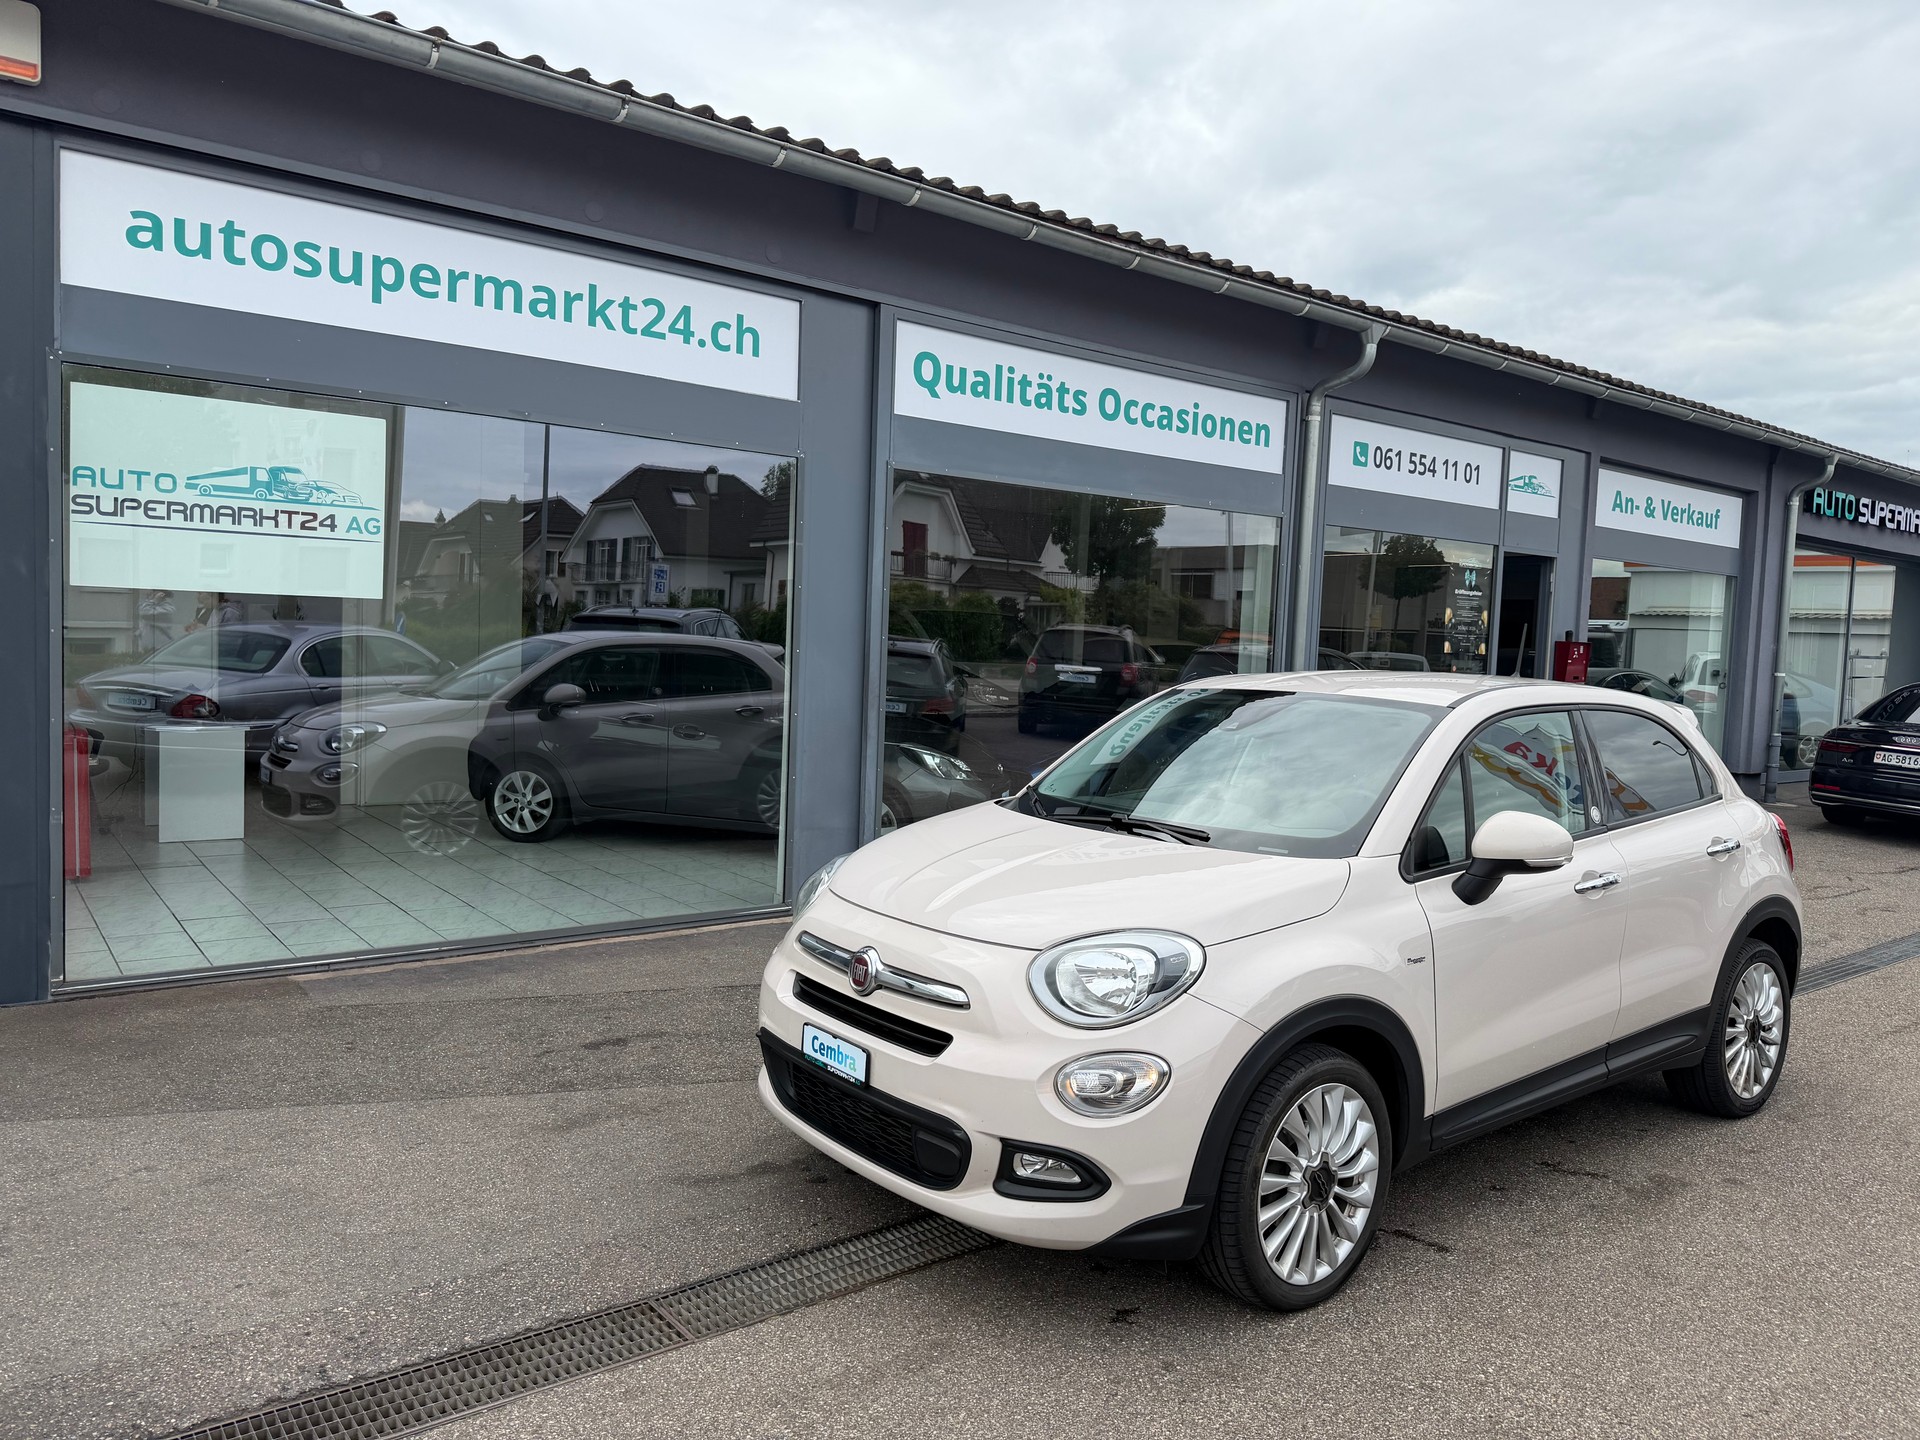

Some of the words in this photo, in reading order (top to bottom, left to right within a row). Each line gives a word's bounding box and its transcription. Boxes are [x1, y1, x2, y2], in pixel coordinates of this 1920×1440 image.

[126, 210, 761, 358] autosupermarkt24.ch
[913, 351, 1088, 416] Qualitäts
[1098, 387, 1271, 448] Occasionen
[72, 465, 177, 494] AUTO
[1373, 445, 1402, 472] 061
[1408, 452, 1437, 478] 554
[1442, 458, 1458, 481] 11
[1464, 462, 1480, 485] 01
[71, 493, 338, 533] SUPERMARKT24
[345, 515, 382, 535] AG
[1611, 490, 1640, 515] An-
[1644, 496, 1656, 519] &
[1661, 498, 1721, 530] Verkauf
[1812, 487, 1856, 521] AUTO
[853, 962, 868, 983] FIAT
[811, 1035, 857, 1073] Cembra
